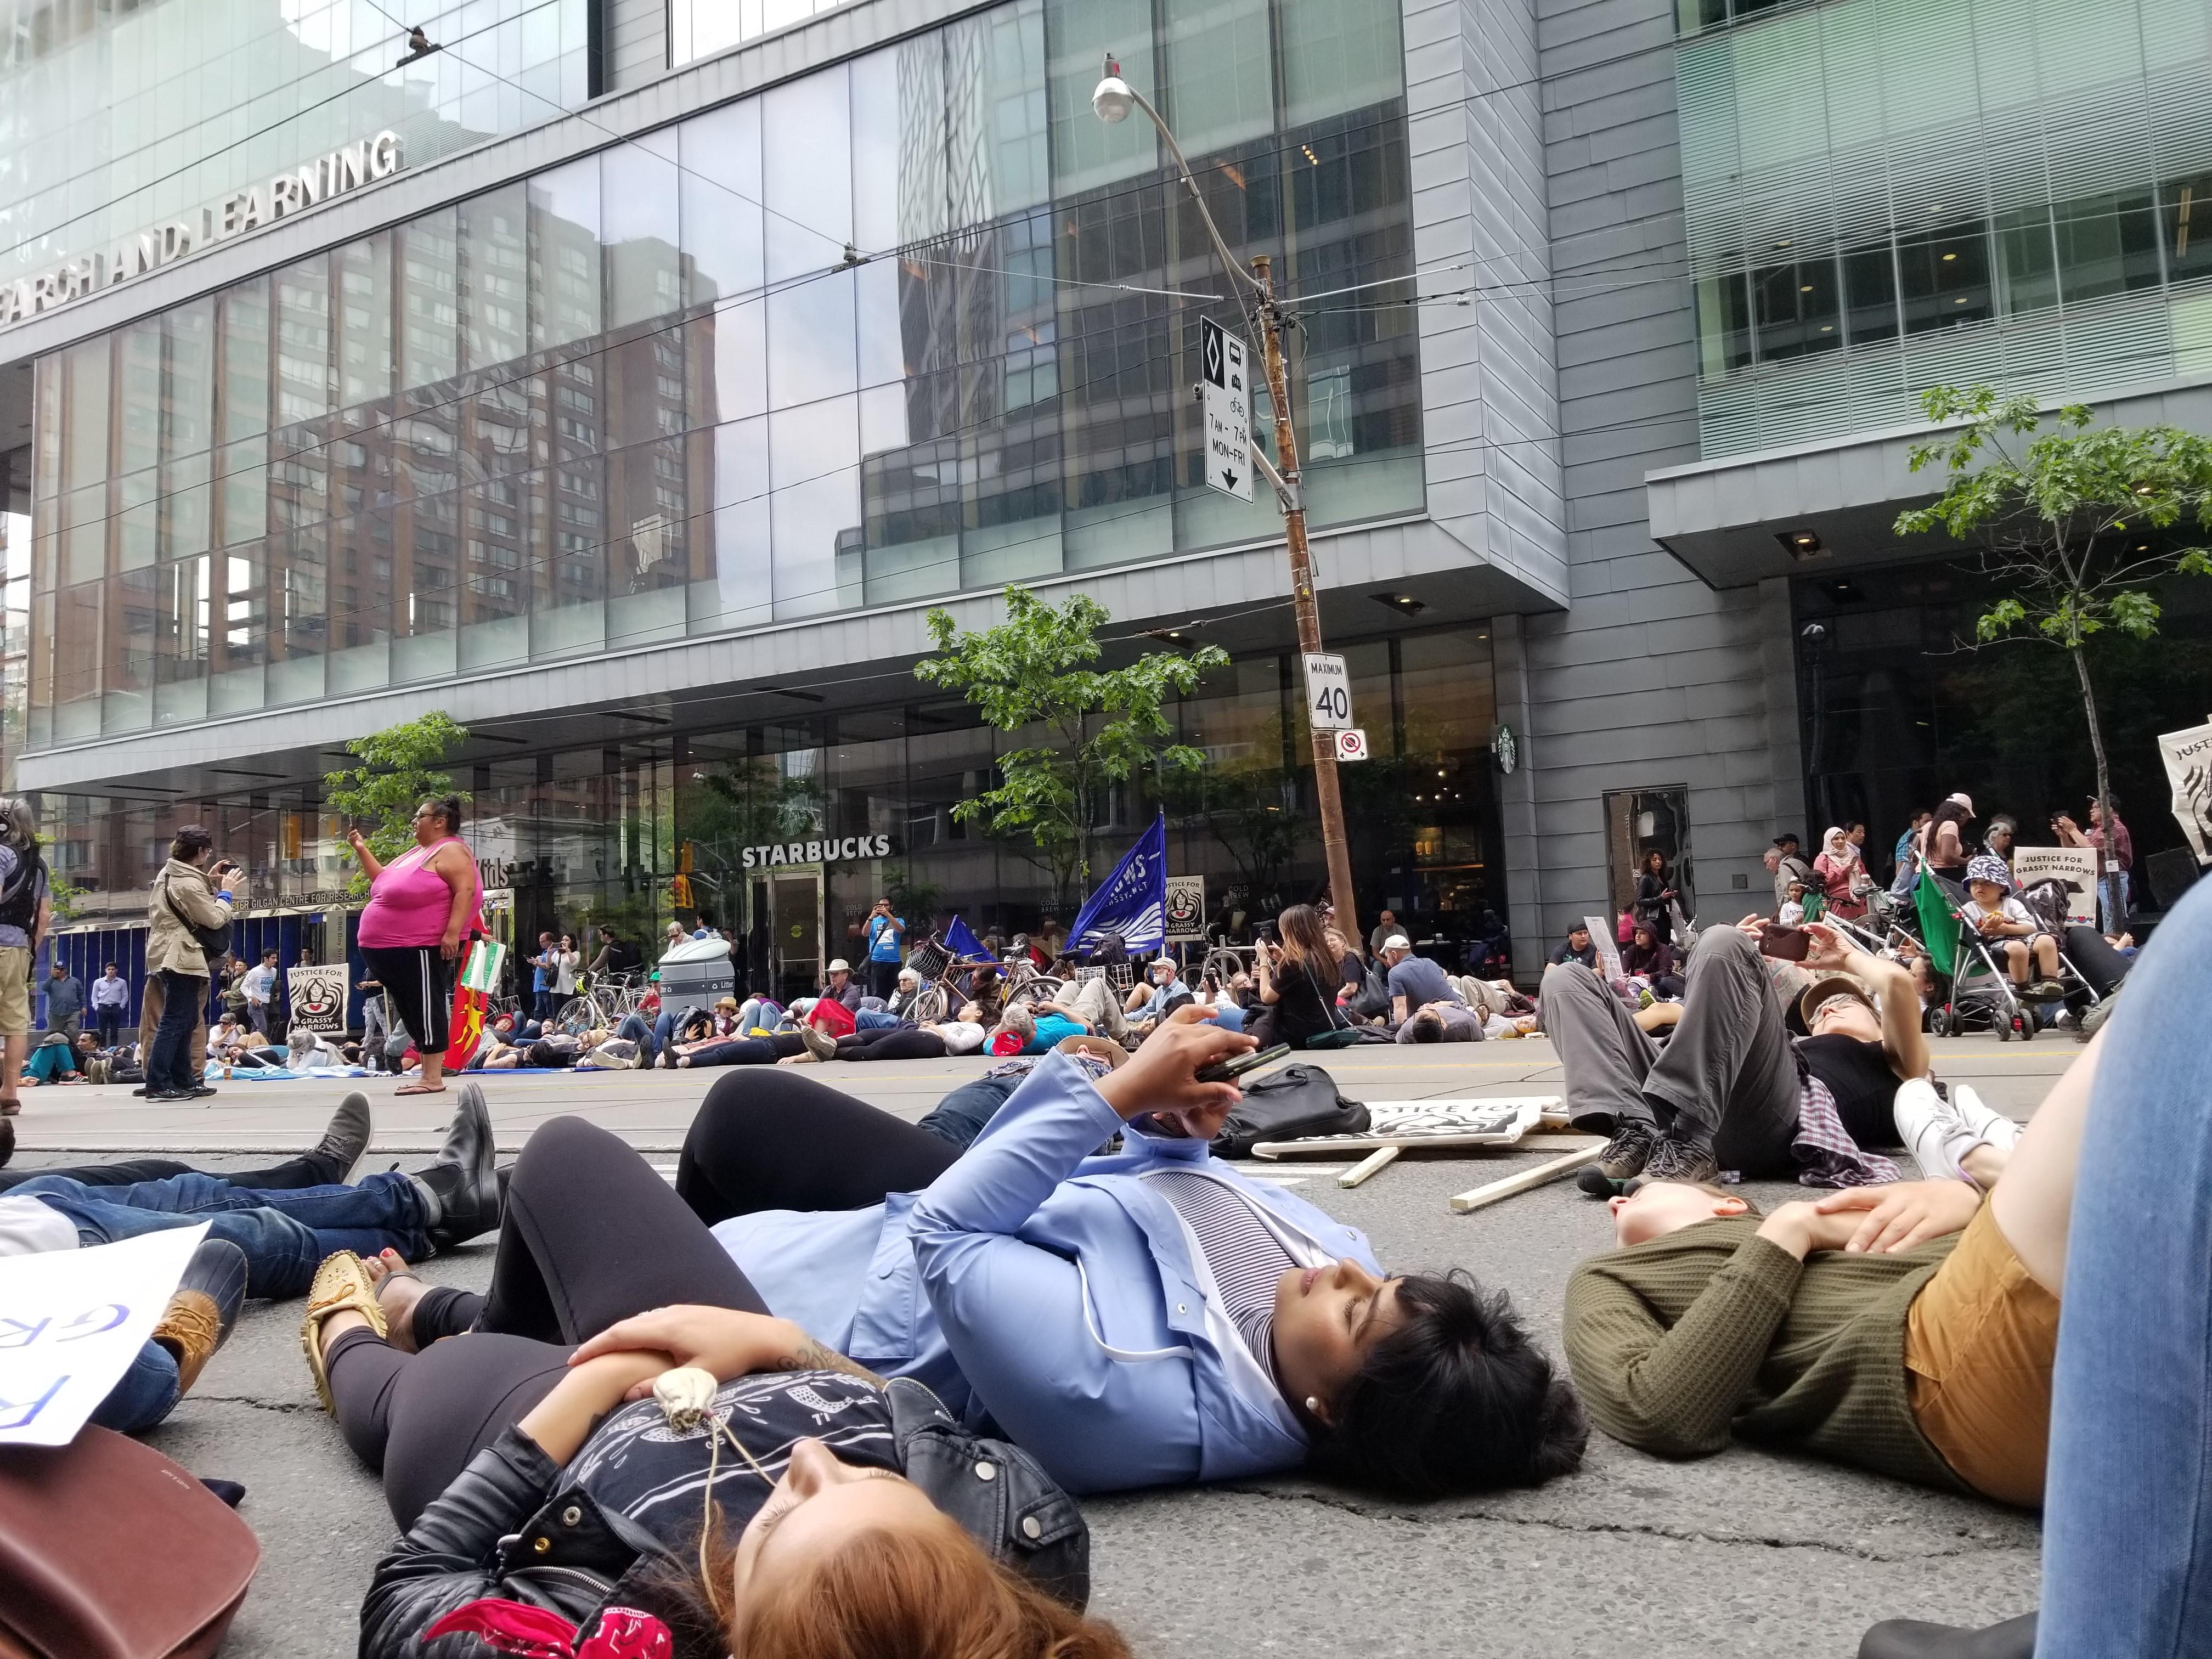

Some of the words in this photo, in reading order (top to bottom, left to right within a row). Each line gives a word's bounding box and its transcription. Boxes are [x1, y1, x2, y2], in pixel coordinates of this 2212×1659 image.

[112, 222, 190, 284] AND
[200, 129, 404, 246] LEARNING
[1212, 438, 1245, 467] MON-FRI
[1302, 588, 1309, 596] 4
[1311, 663, 1342, 675] MAXIMUM
[1316, 687, 1347, 720] 40
[2176, 737, 2212, 760] JUST
[742, 834, 890, 868] STARBUCKS
[2016, 865, 2049, 874] GRASSY
[2052, 865, 2096, 876] NARROWS
[230, 900, 249, 910] ETER
[252, 897, 278, 909] GILGAN
[280, 894, 309, 906] CENTRE
[311, 893, 326, 903] FOR
[329, 889, 370, 902] RESEARCH
[290, 969, 323, 979] JUSTICE
[721, 980, 733, 989] Litter
[301, 1017, 334, 1025] GRASSY
[1366, 1105, 1460, 1114] STICE
